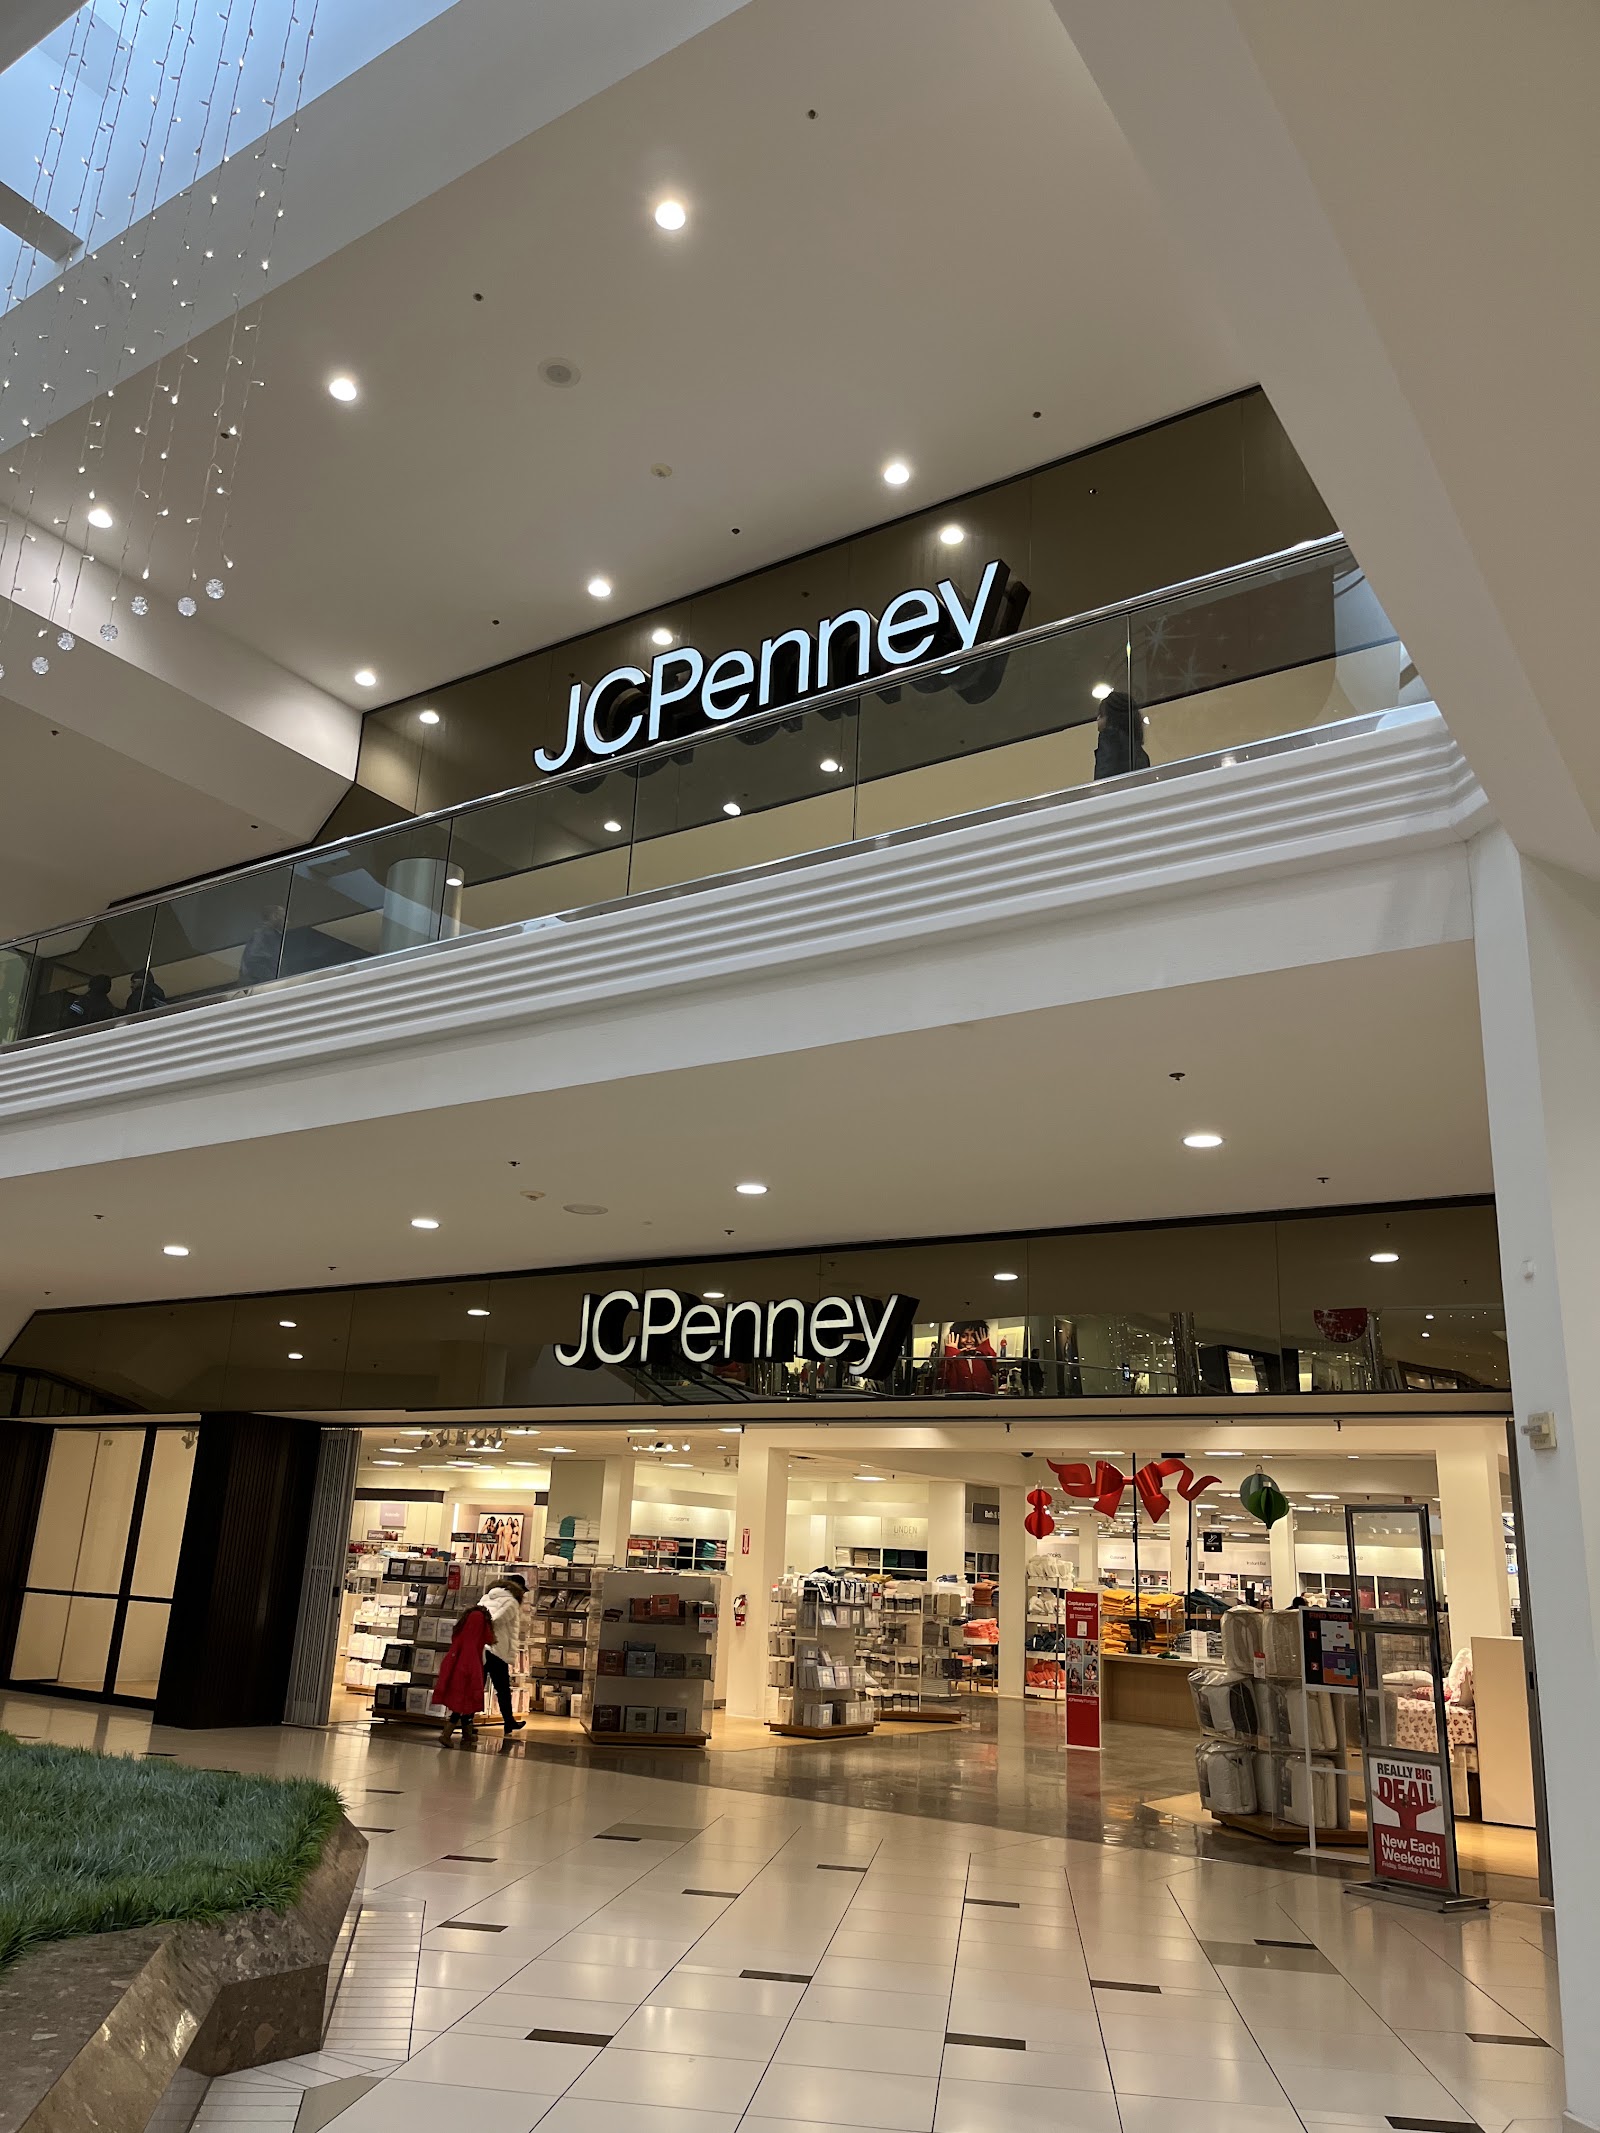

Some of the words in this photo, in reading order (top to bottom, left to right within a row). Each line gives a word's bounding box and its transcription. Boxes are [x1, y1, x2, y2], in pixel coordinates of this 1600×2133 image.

[533, 559, 1001, 772] JCPenney
[554, 1288, 900, 1376] JCPenney
[1377, 1762, 1413, 1779] REALLY
[1415, 1767, 1433, 1782] BIG
[1378, 1776, 1435, 1806] DEAL!
[1380, 1832, 1408, 1850] New
[1409, 1837, 1441, 1856] Each
[1381, 1846, 1441, 1870] Weekend!
